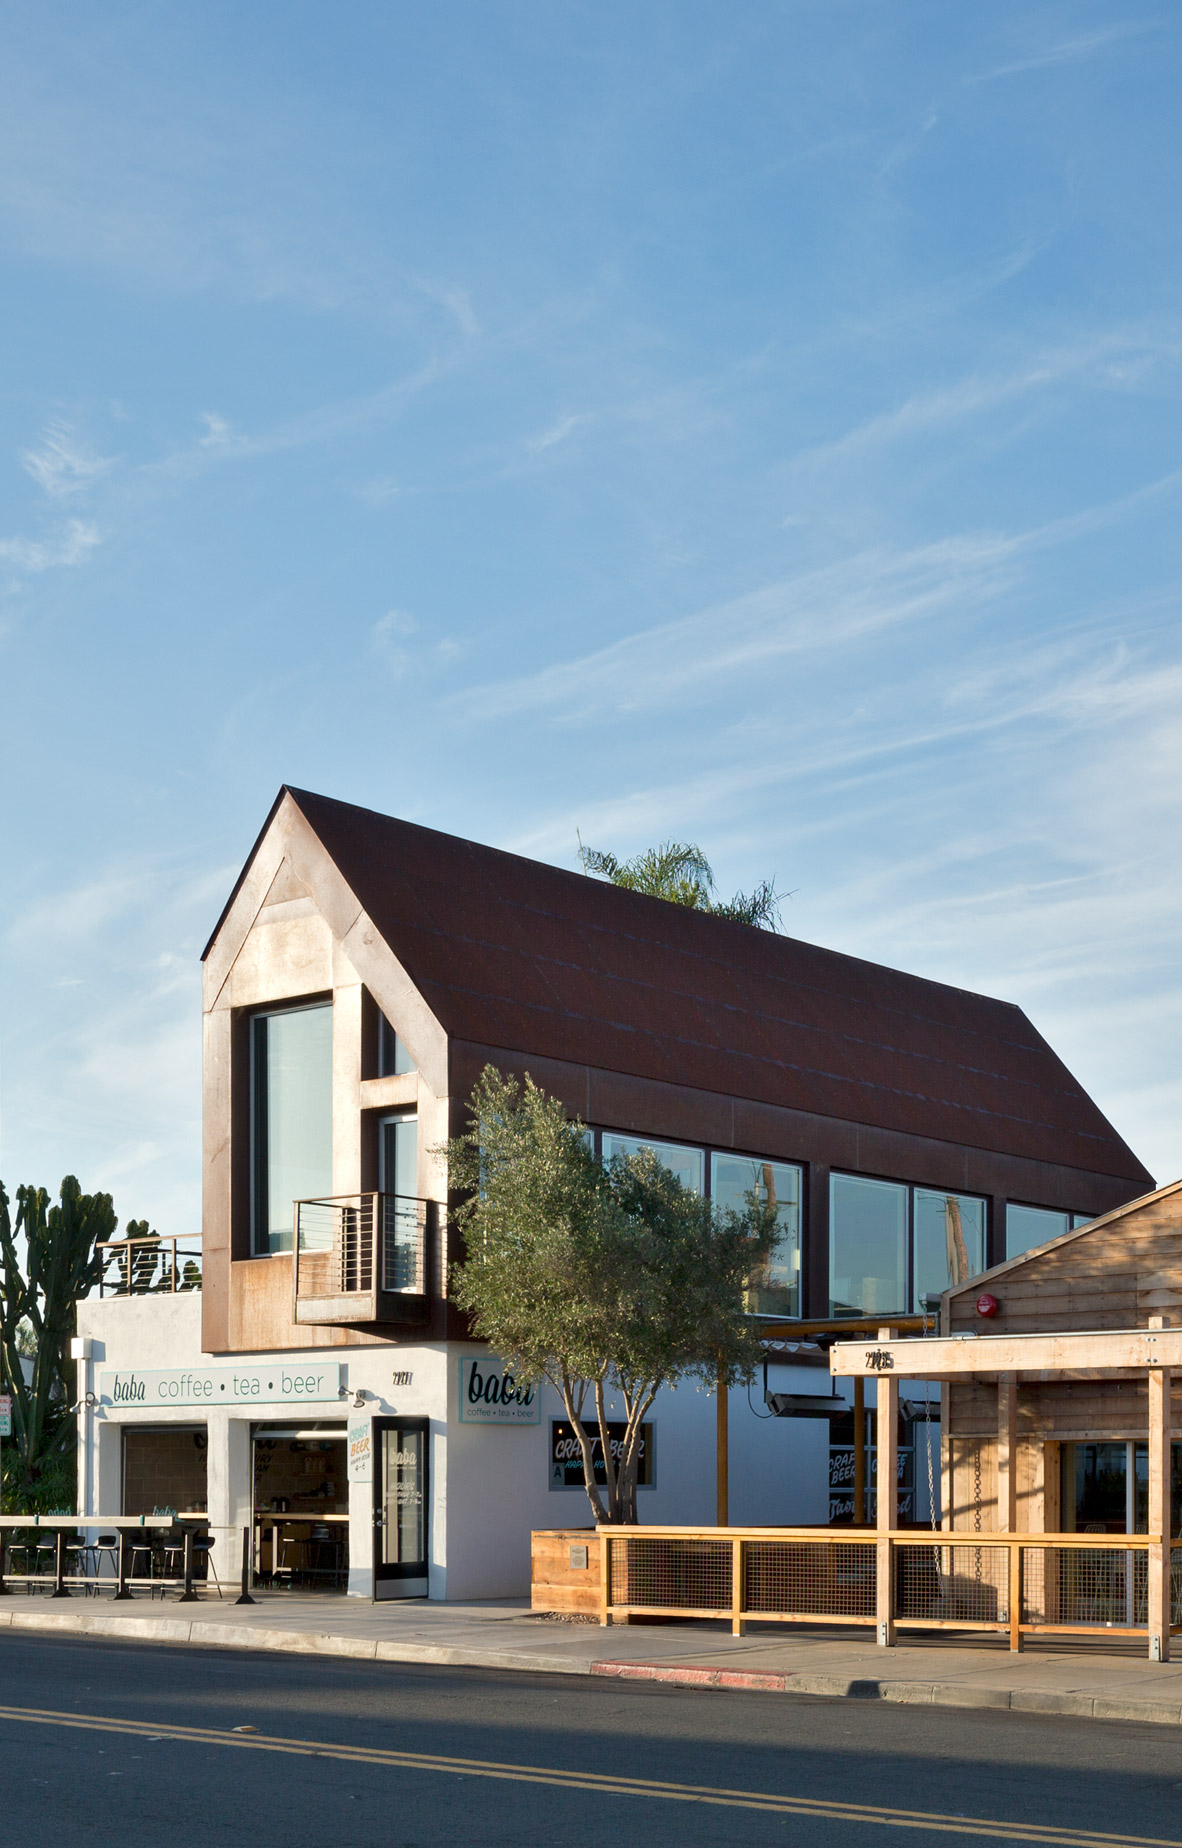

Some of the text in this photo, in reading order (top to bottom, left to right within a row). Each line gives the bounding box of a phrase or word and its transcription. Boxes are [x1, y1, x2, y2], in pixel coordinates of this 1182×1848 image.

[113, 1371, 324, 1401] baba coffee tea beer
[467, 1408, 534, 1417] coffee tea beer
[350, 1438, 370, 1456] BEER
[555, 1437, 602, 1459] CRAT
[829, 1453, 855, 1472] CRAF
[554, 1466, 562, 1478] A
